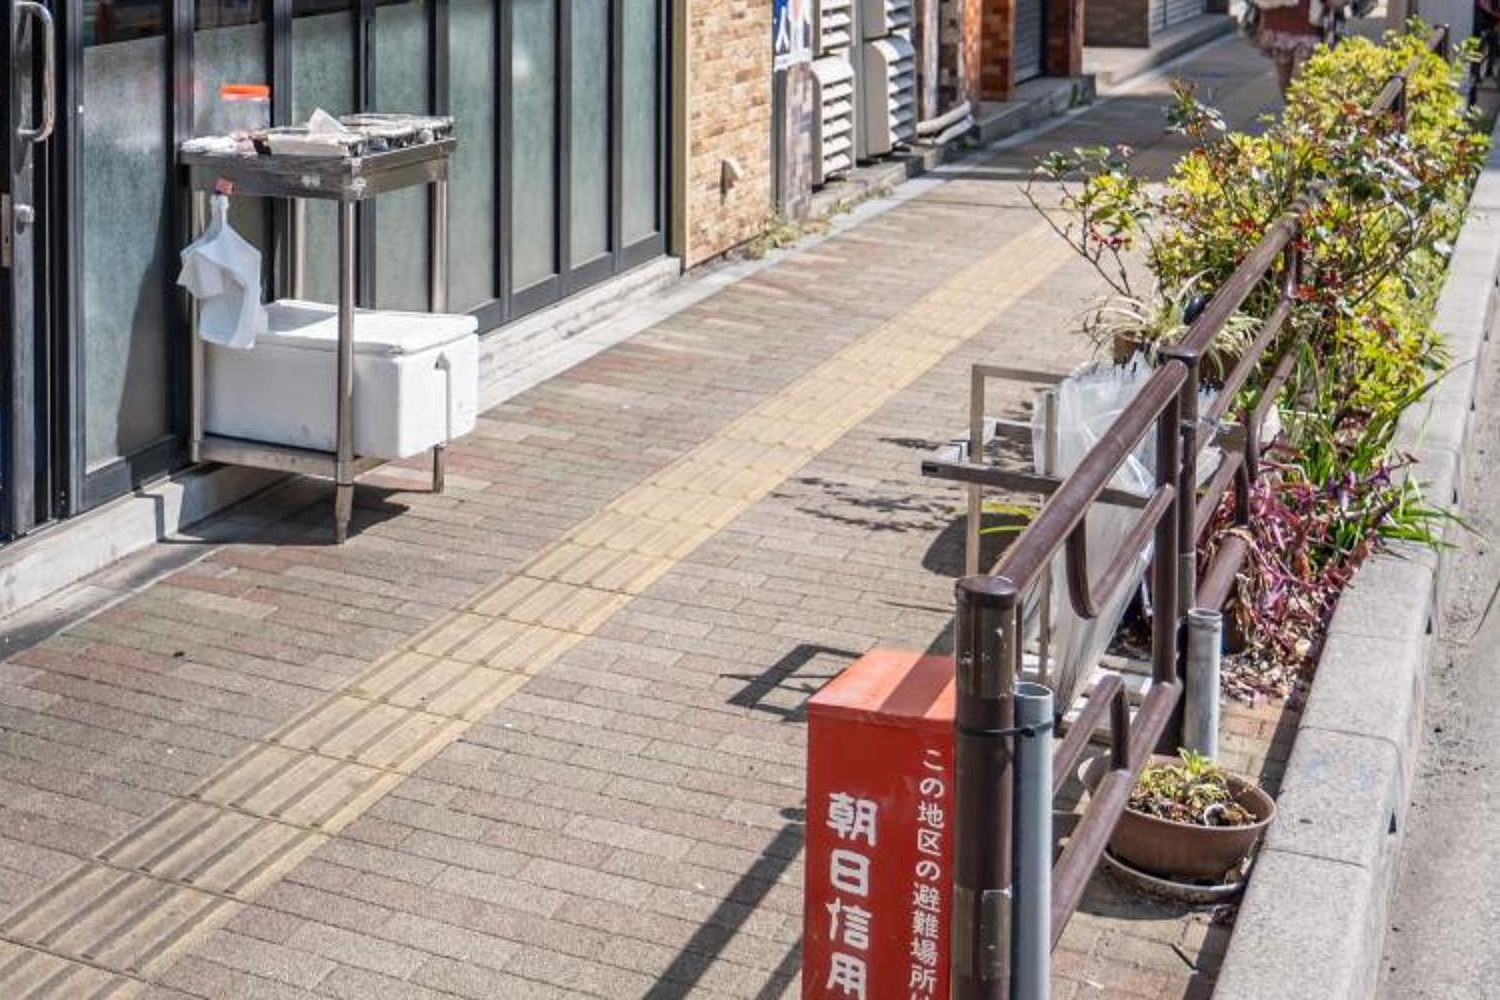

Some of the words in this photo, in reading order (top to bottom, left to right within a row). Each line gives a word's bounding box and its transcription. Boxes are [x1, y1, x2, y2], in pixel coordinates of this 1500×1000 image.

[825, 792, 877, 1000] 朝日信用
[909, 749, 946, 1000] この地区の避難場所
